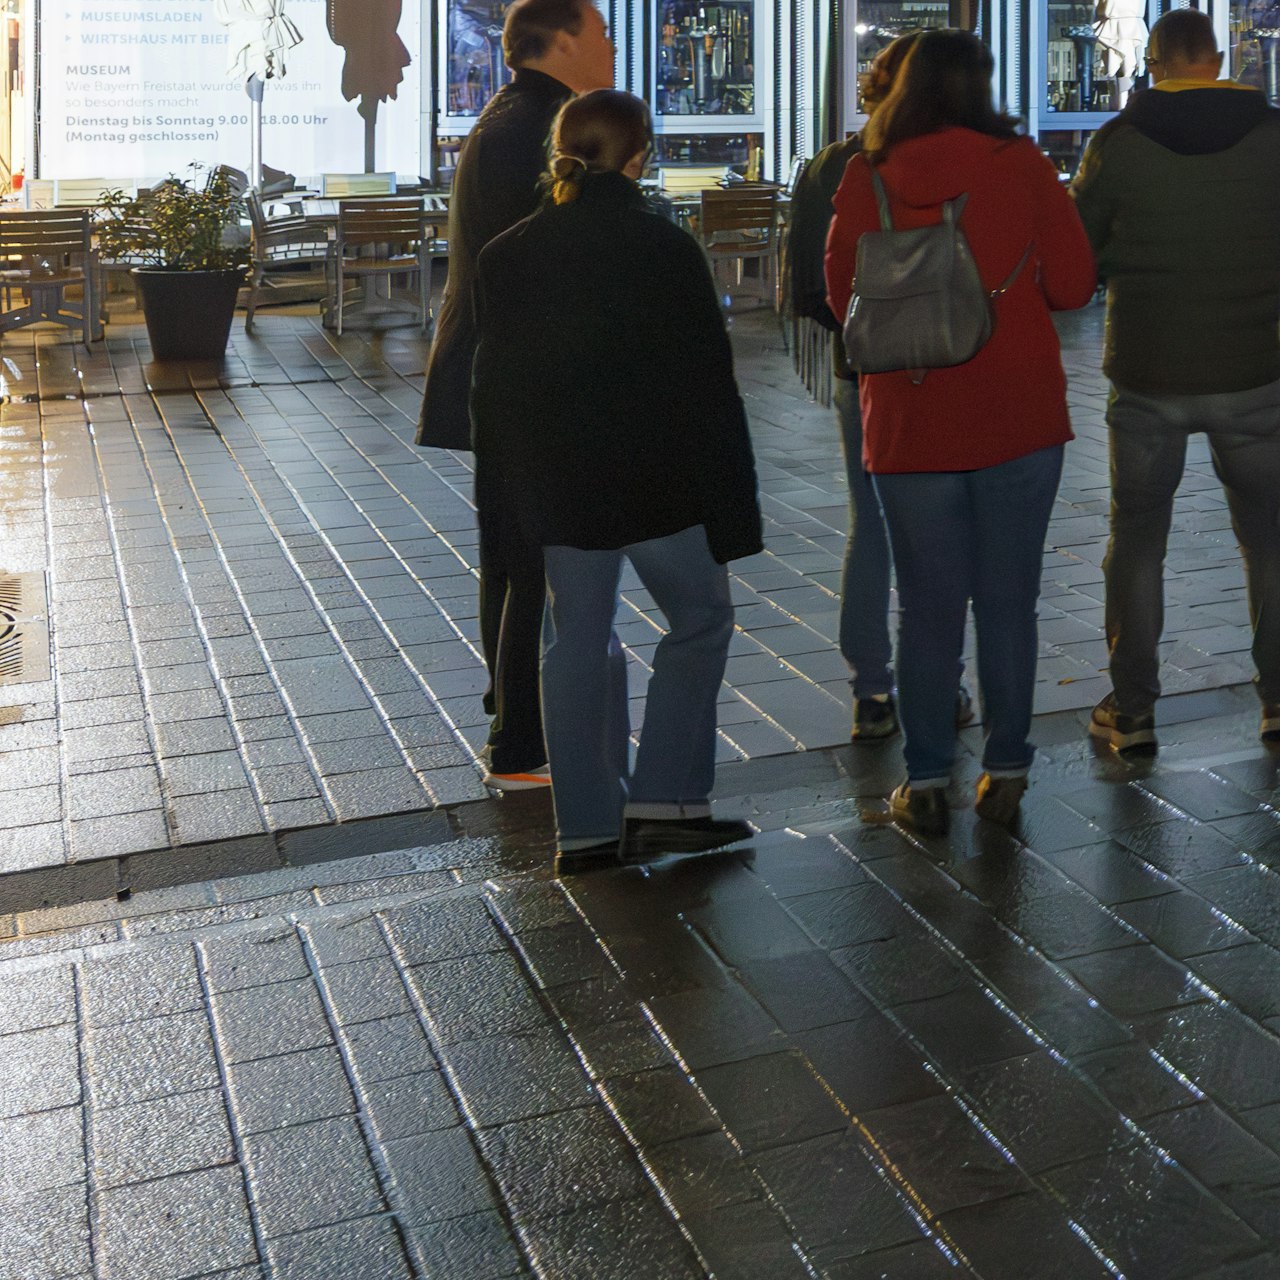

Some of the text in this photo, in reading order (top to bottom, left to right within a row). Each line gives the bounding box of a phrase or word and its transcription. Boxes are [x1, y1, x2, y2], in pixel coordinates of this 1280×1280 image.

[81, 11, 202, 22] MUSEUMSLADEN
[81, 34, 167, 44] WIRTSHAUS
[171, 34, 197, 44] MIT
[66, 65, 131, 75] MUSEUM
[65, 81, 92, 92] Wie
[94, 81, 140, 94] Bayern
[143, 81, 197, 92] Freistaat
[200, 81, 241, 92] wurde
[273, 83, 298, 92] was
[302, 81, 321, 92] ihn
[65, 97, 199, 108] so besonders macht
[66, 115, 328, 128] Dienstag bis Sonntag 9.00 18.00 Uhr
[65, 131, 219, 143] (Montag geschlossen)
